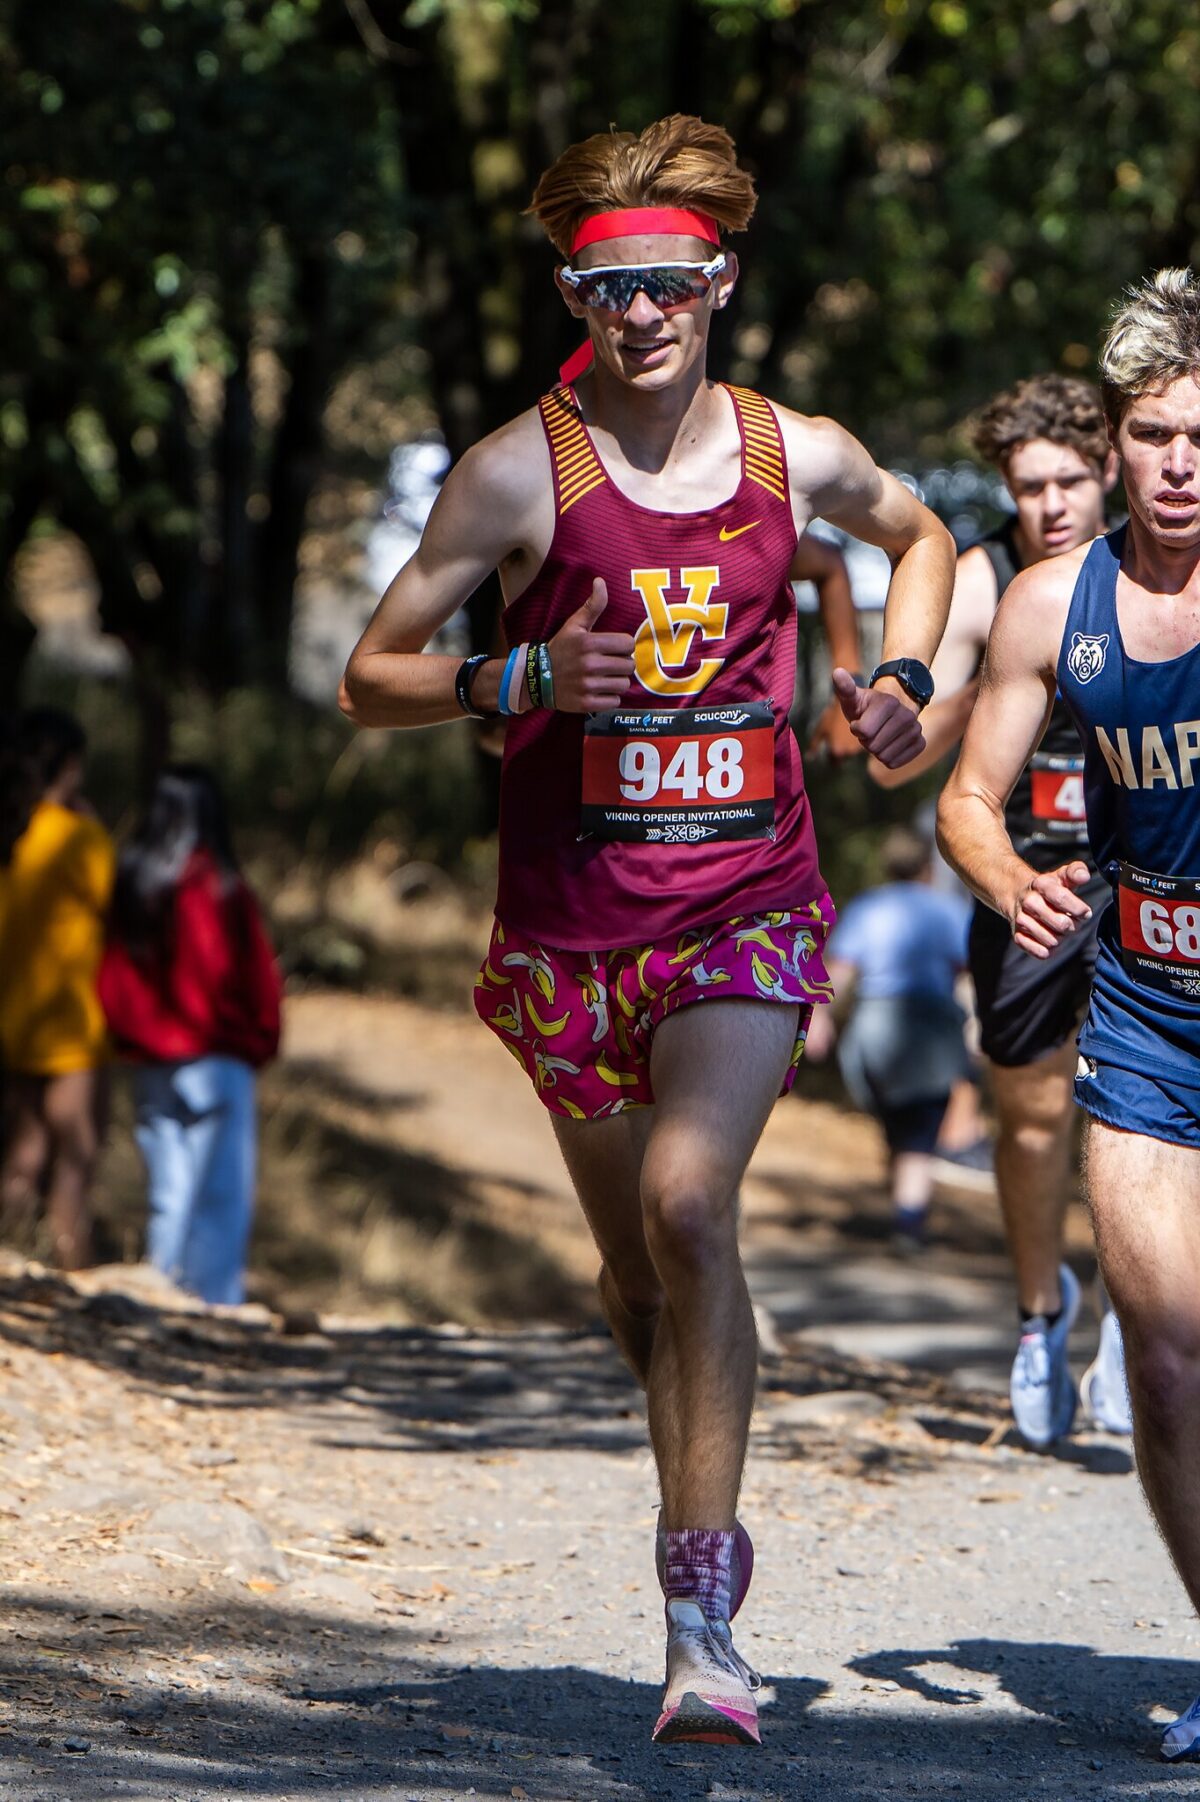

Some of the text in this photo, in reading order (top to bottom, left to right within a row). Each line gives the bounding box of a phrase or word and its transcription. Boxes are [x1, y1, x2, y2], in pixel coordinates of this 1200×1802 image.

[527, 661, 536, 677] Run
[614, 715, 675, 724] FLEET FEET
[694, 709, 740, 723] saucony
[618, 737, 744, 801] 948
[605, 808, 756, 823] VIKING OPENER INVITATIONAL
[664, 823, 700, 843] XC
[1132, 873, 1177, 890] FLEET FEET
[1139, 900, 1200, 959] 68
[1136, 957, 1200, 978] VIKING OPENER
